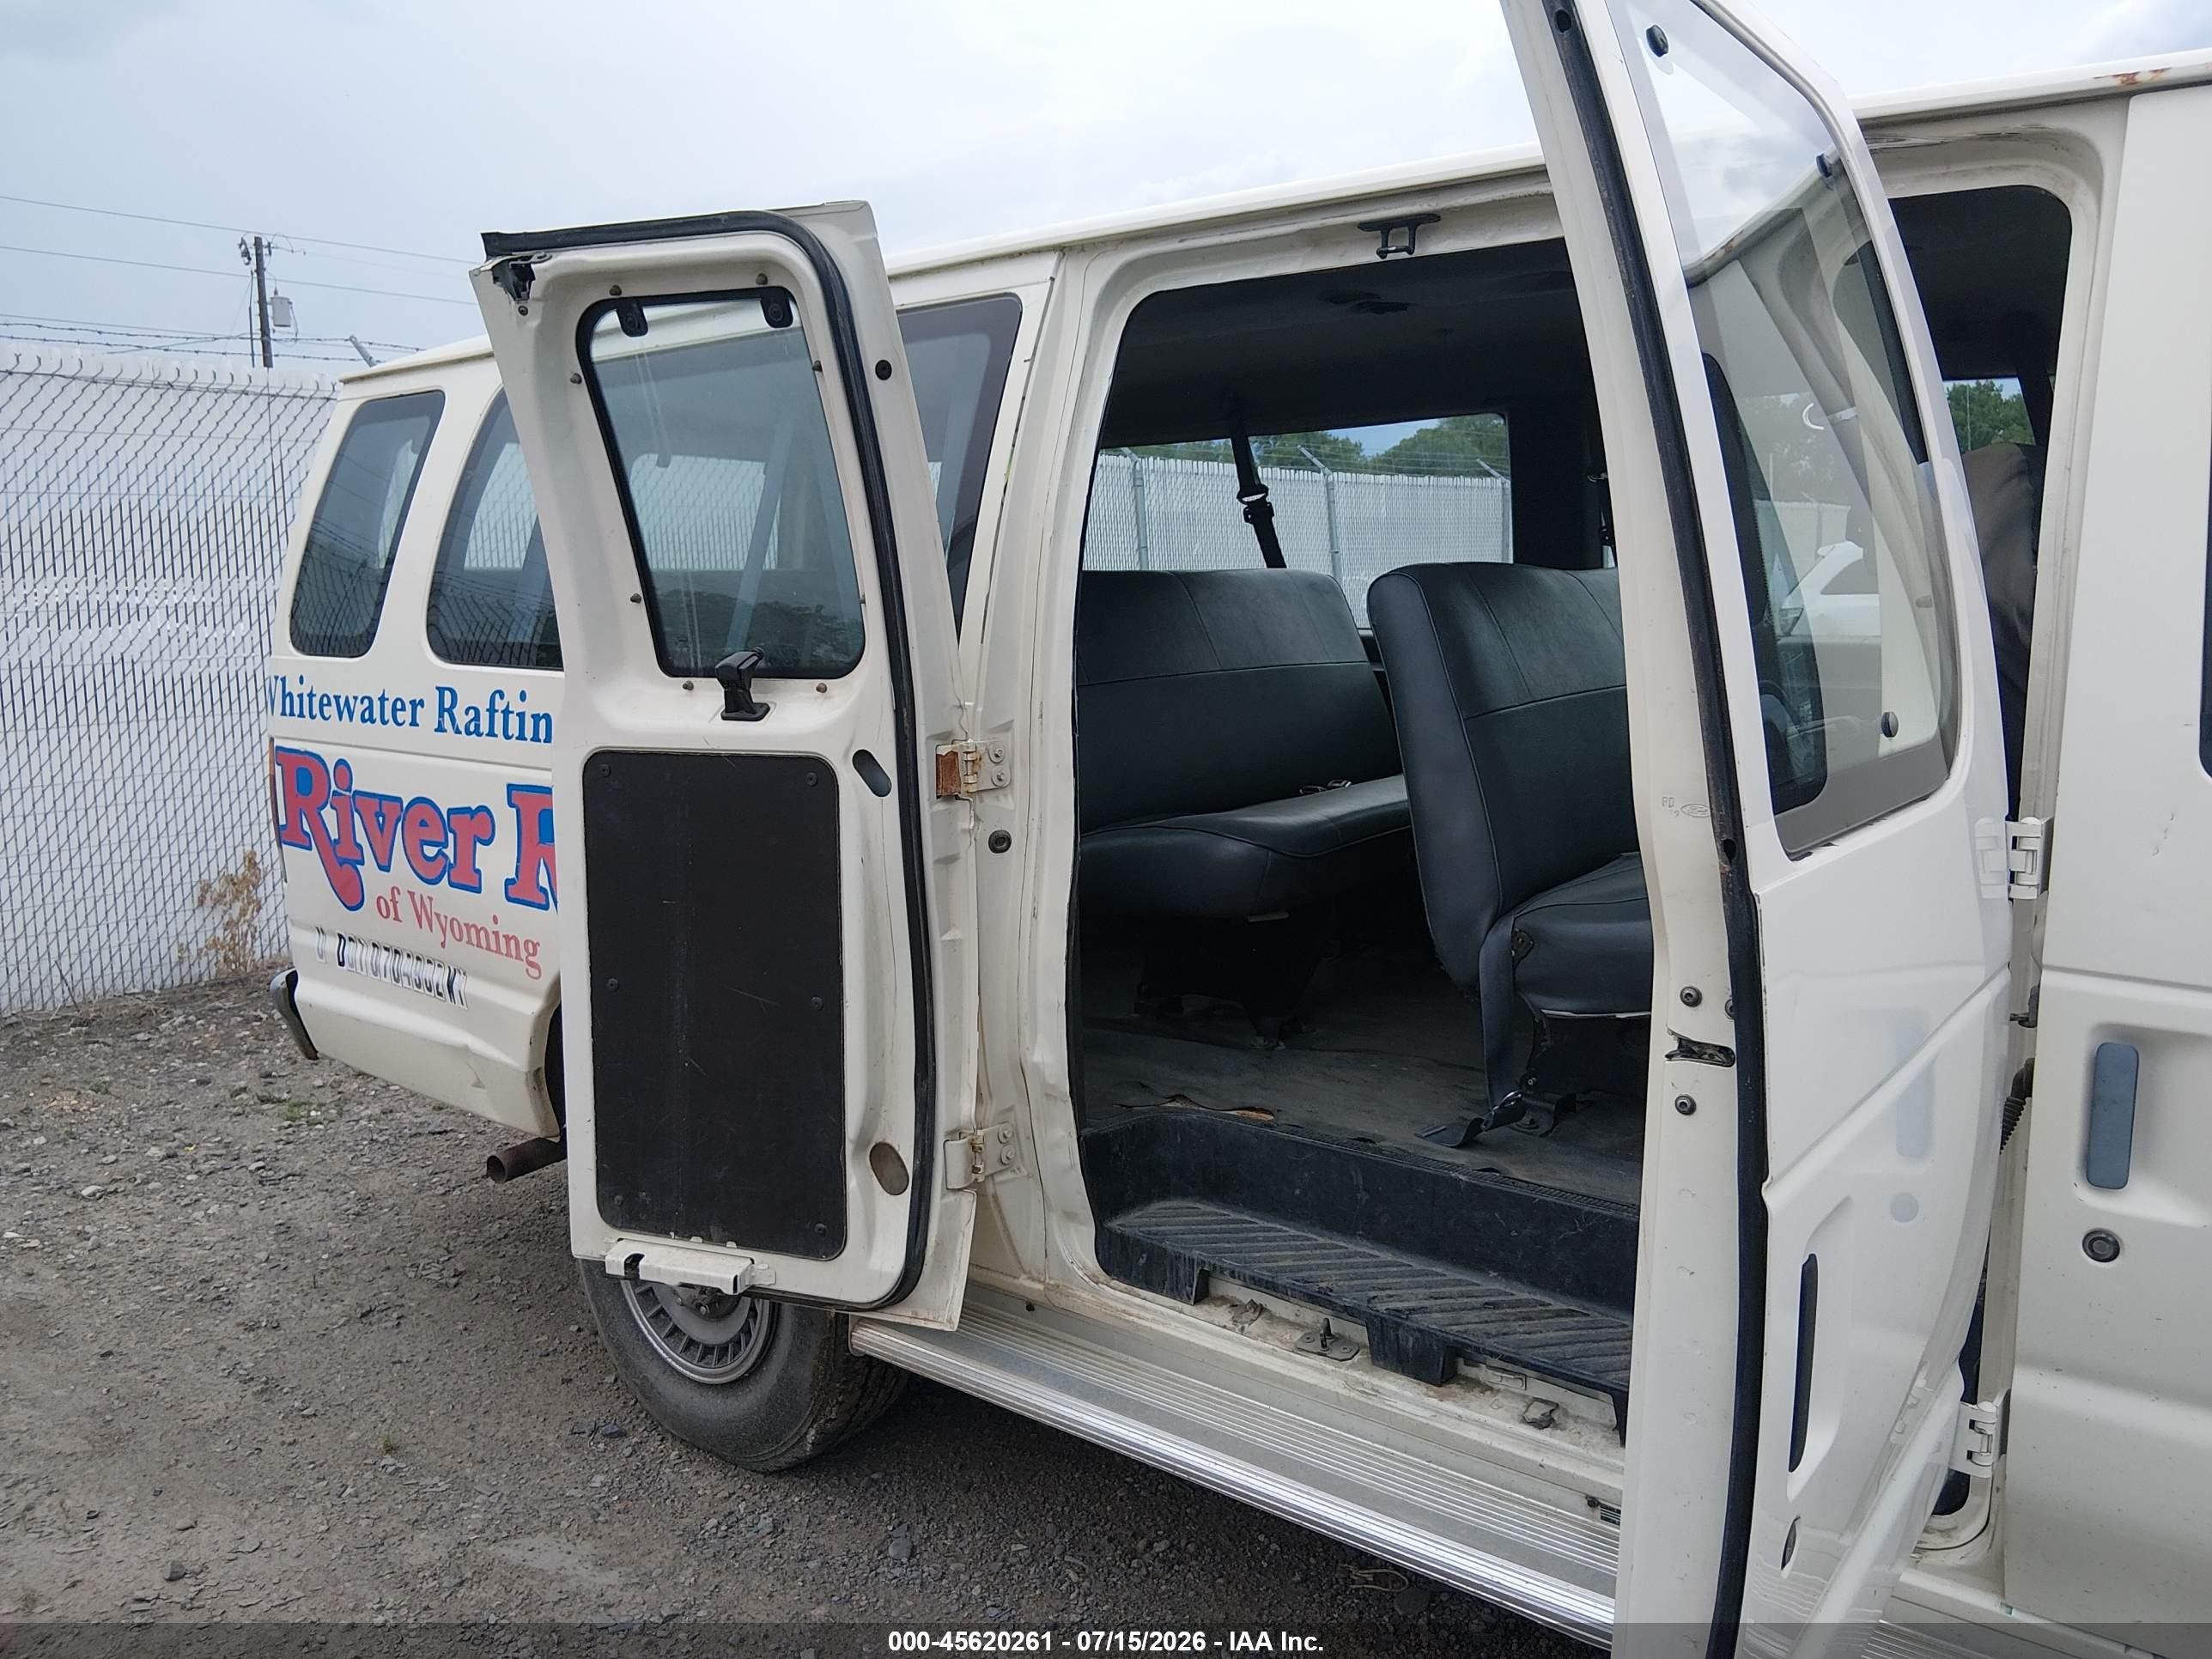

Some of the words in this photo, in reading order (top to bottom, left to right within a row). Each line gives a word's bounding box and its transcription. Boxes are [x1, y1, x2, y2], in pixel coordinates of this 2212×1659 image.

[275, 745, 496, 912] River
[375, 885, 403, 922] of
[407, 889, 541, 980] Wyoming
